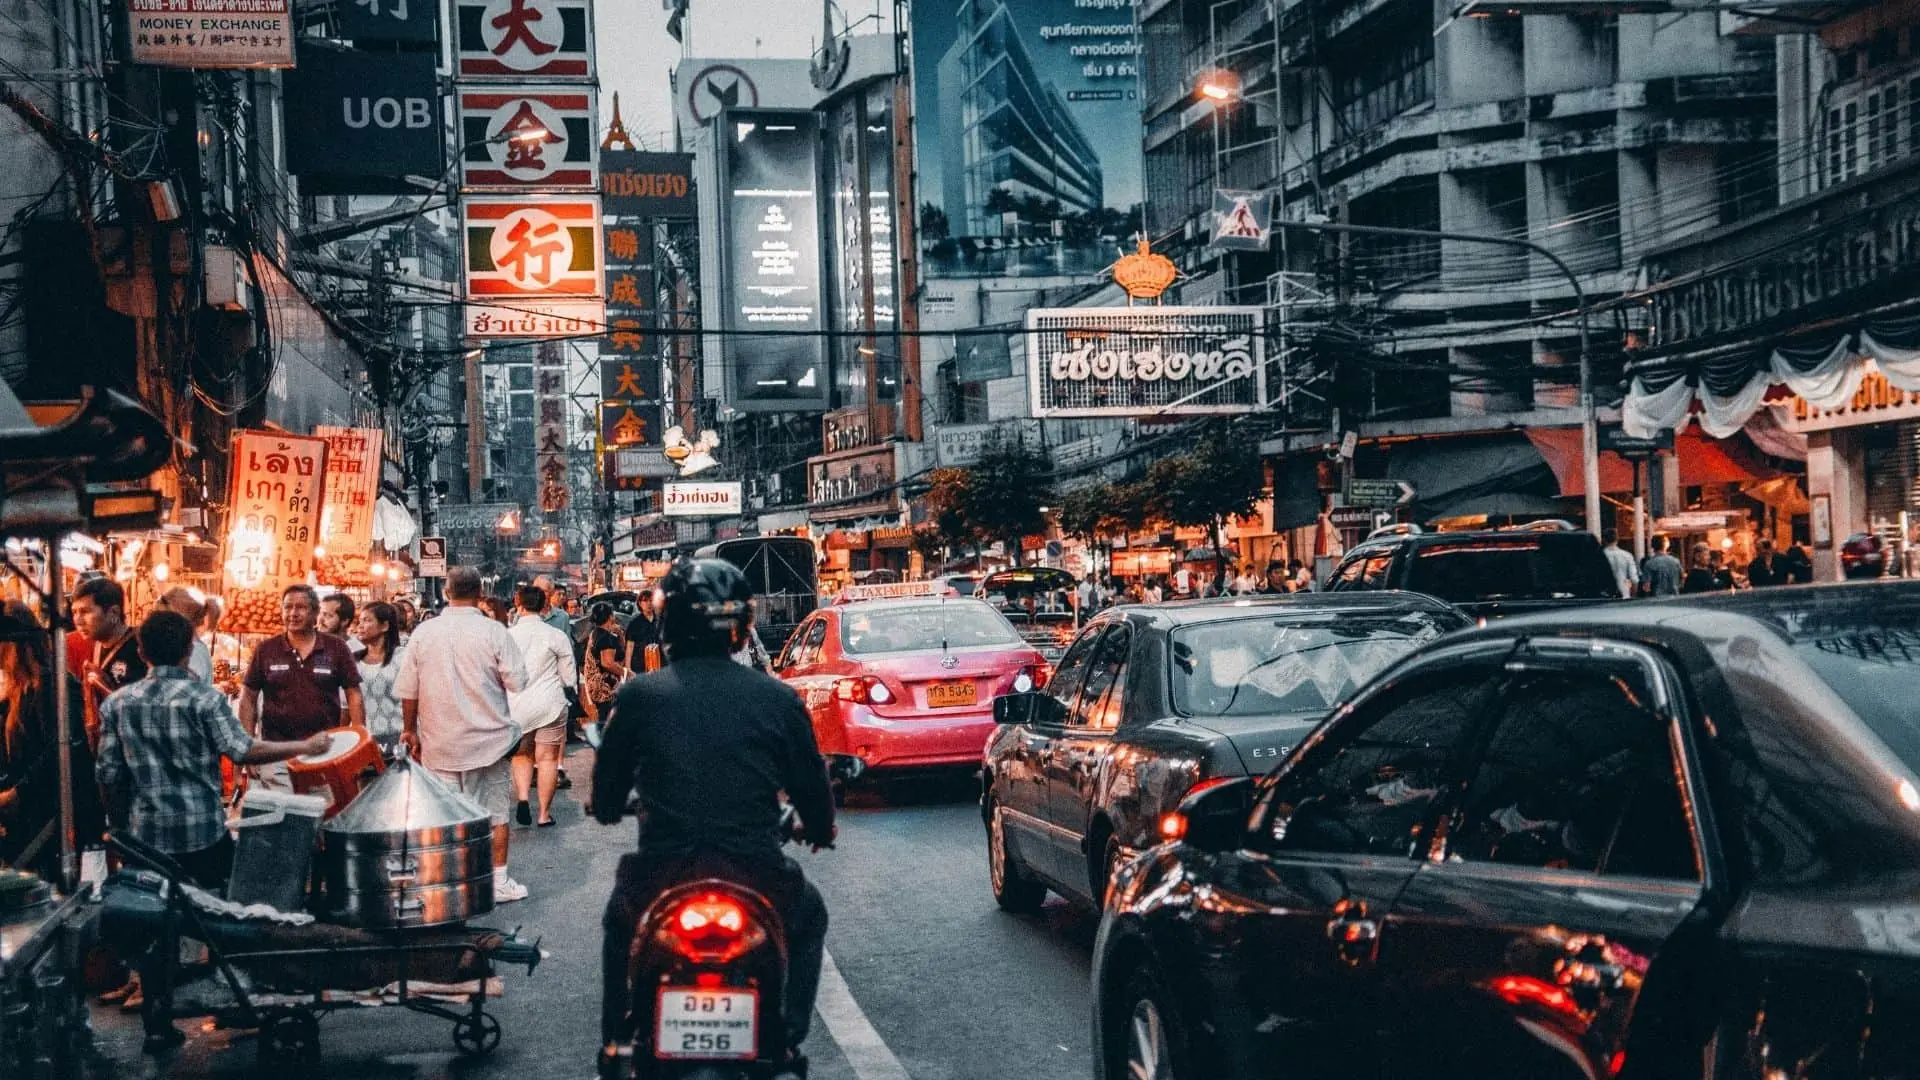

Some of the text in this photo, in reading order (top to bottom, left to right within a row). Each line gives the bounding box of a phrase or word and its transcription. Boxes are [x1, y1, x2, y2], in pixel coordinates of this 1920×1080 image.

[139, 18, 281, 31] MONEY EXCHANGE
[1106, 64, 1114, 76] 9
[343, 97, 431, 129] UOB
[249, 442, 314, 476] เล้ง
[246, 479, 286, 502] เกา
[289, 483, 310, 513] คั่ว
[286, 517, 309, 543] มือ
[682, 1032, 731, 1050] 256
